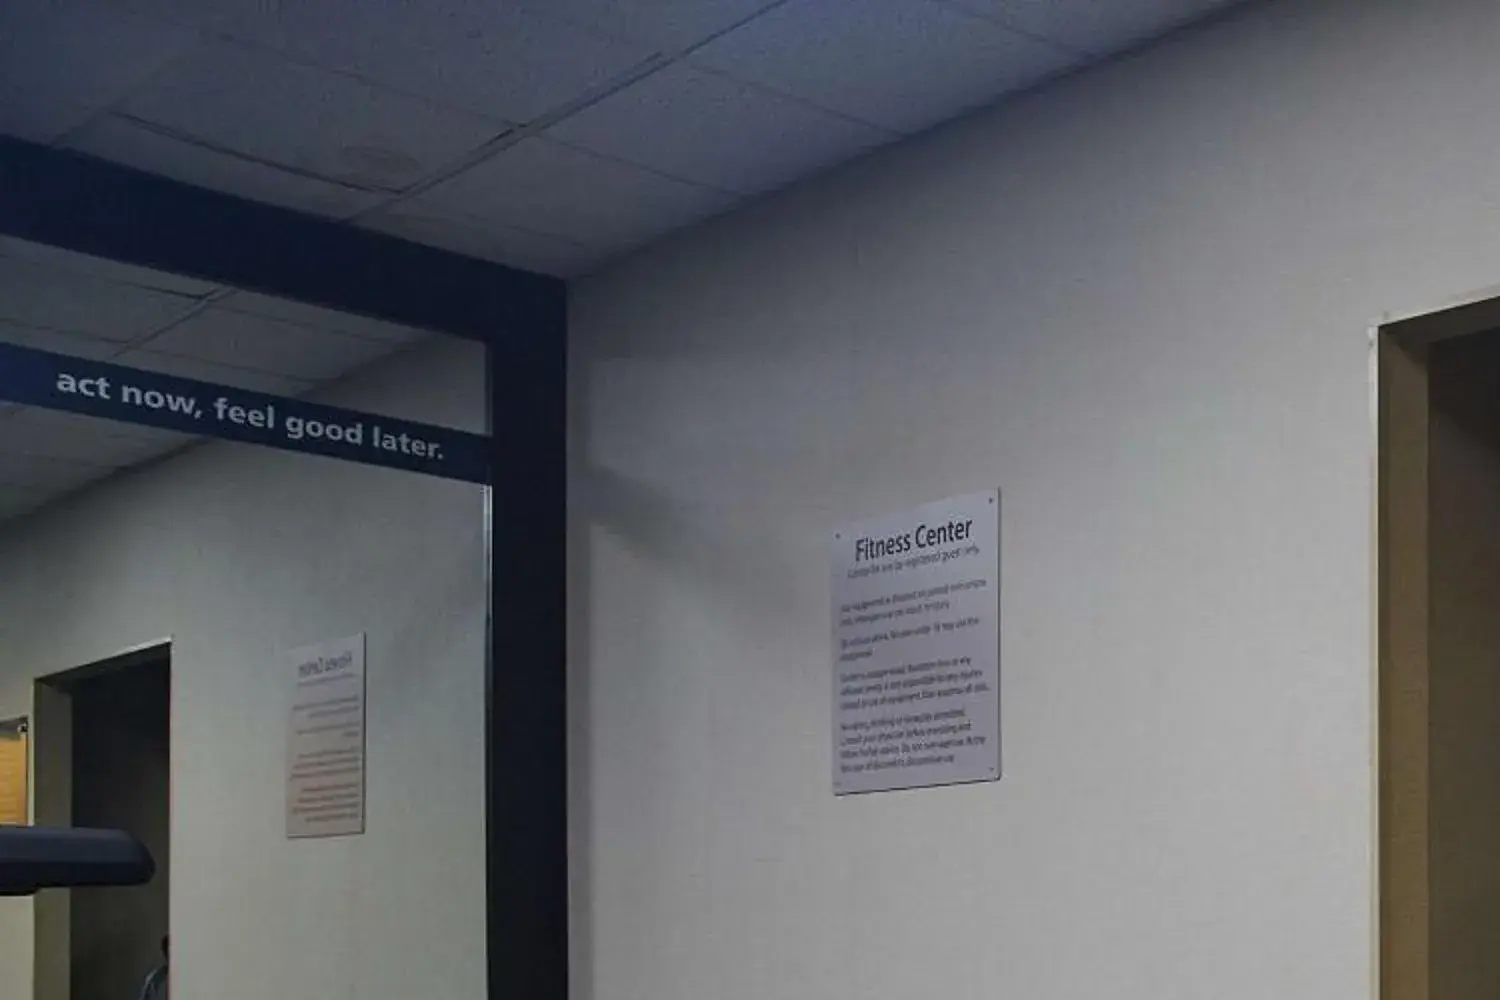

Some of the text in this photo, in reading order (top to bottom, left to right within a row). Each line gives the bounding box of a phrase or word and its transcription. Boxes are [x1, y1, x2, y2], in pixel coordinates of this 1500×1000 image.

[56, 373, 444, 460] act now, feel good later.
[855, 532, 911, 562] Fitness
[914, 519, 973, 549] Center
